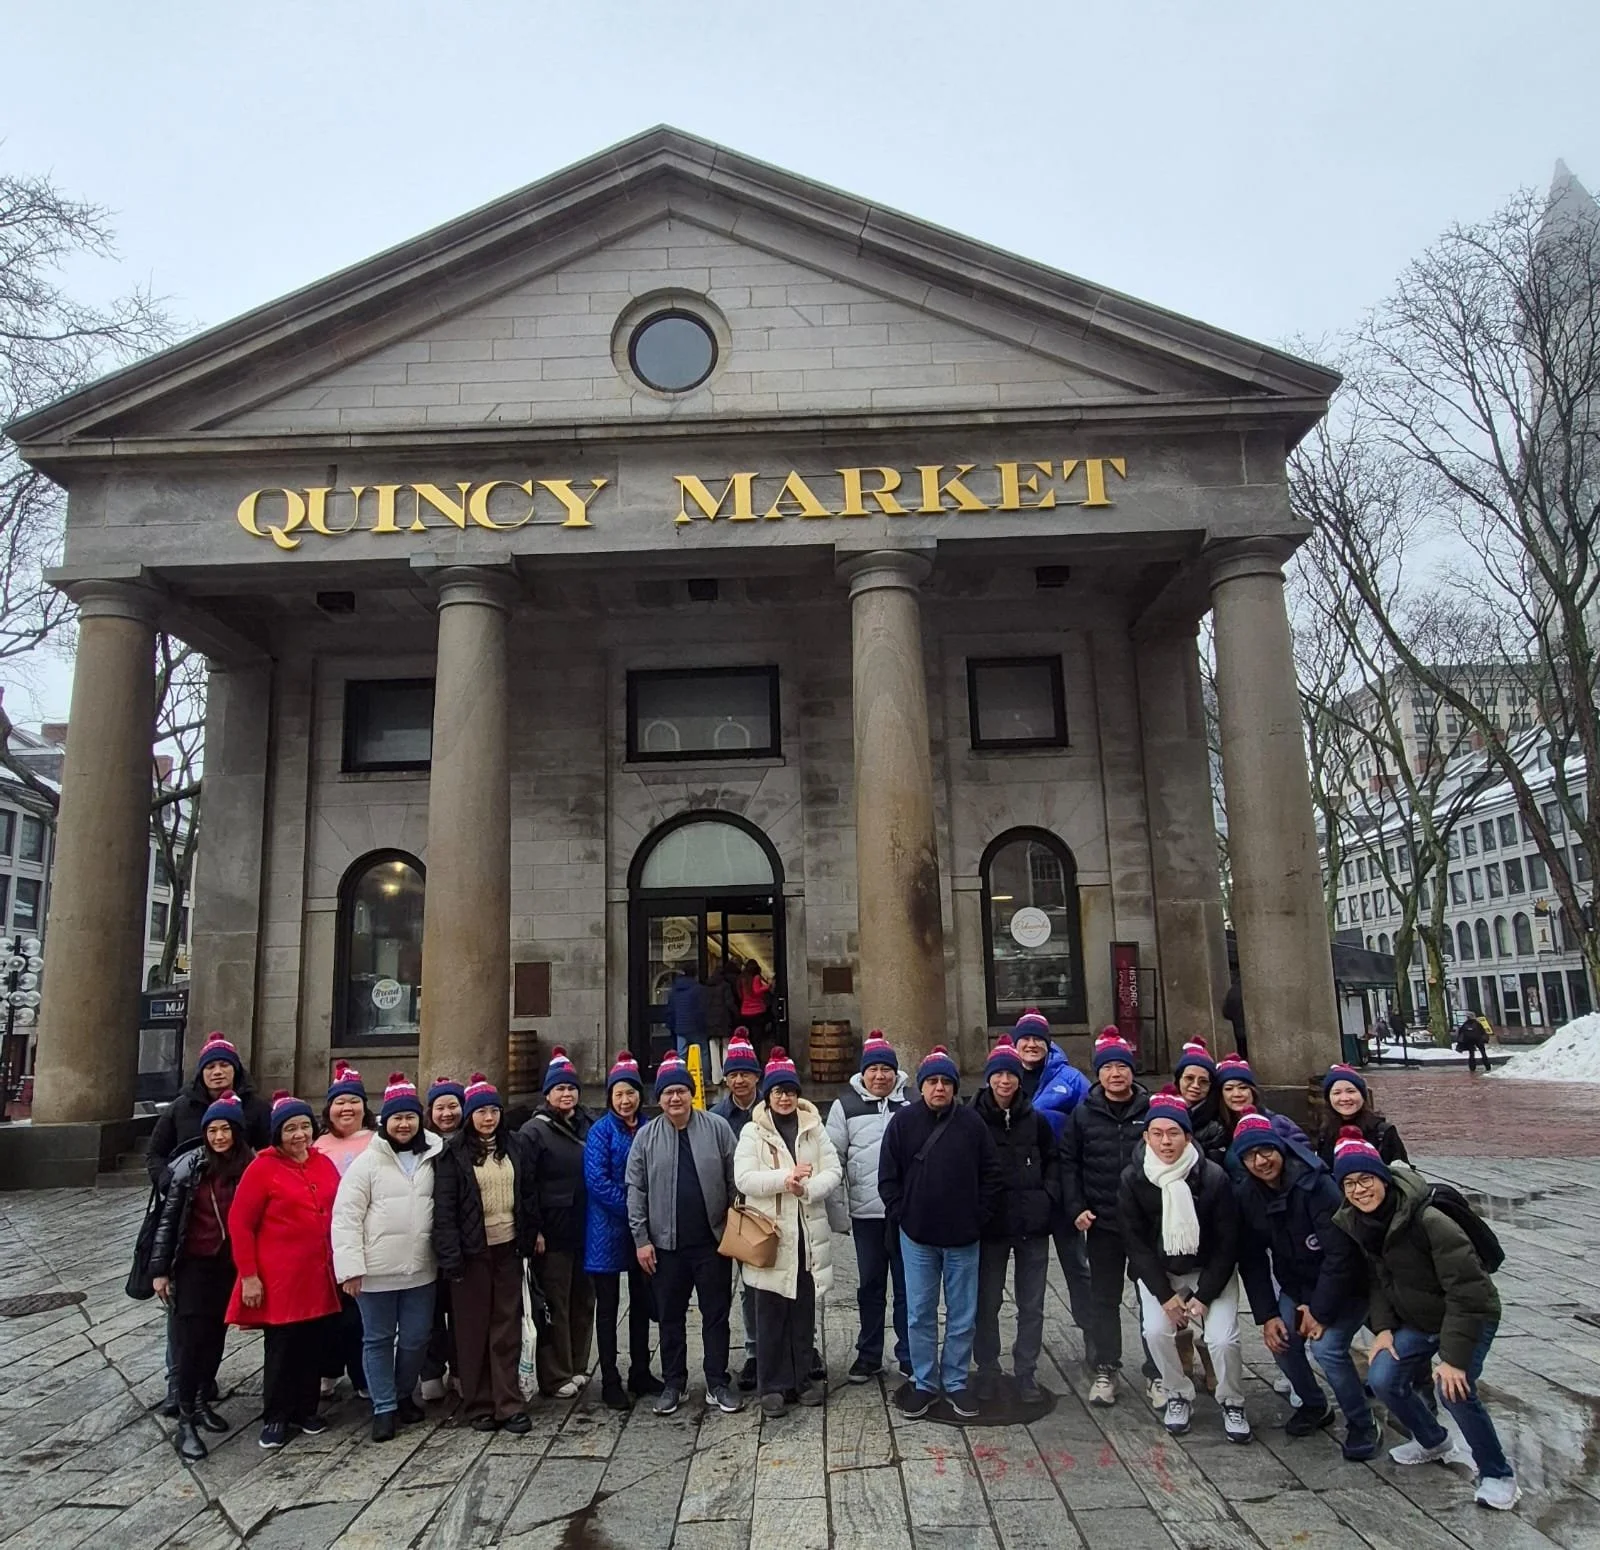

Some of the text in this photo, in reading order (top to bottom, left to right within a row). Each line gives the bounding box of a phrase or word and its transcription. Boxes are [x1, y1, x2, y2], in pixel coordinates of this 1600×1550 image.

[237, 457, 1127, 550] QUINCY MARKET
[1539, 928, 1550, 943] 1
[1129, 966, 1138, 1008] HISTORIC
